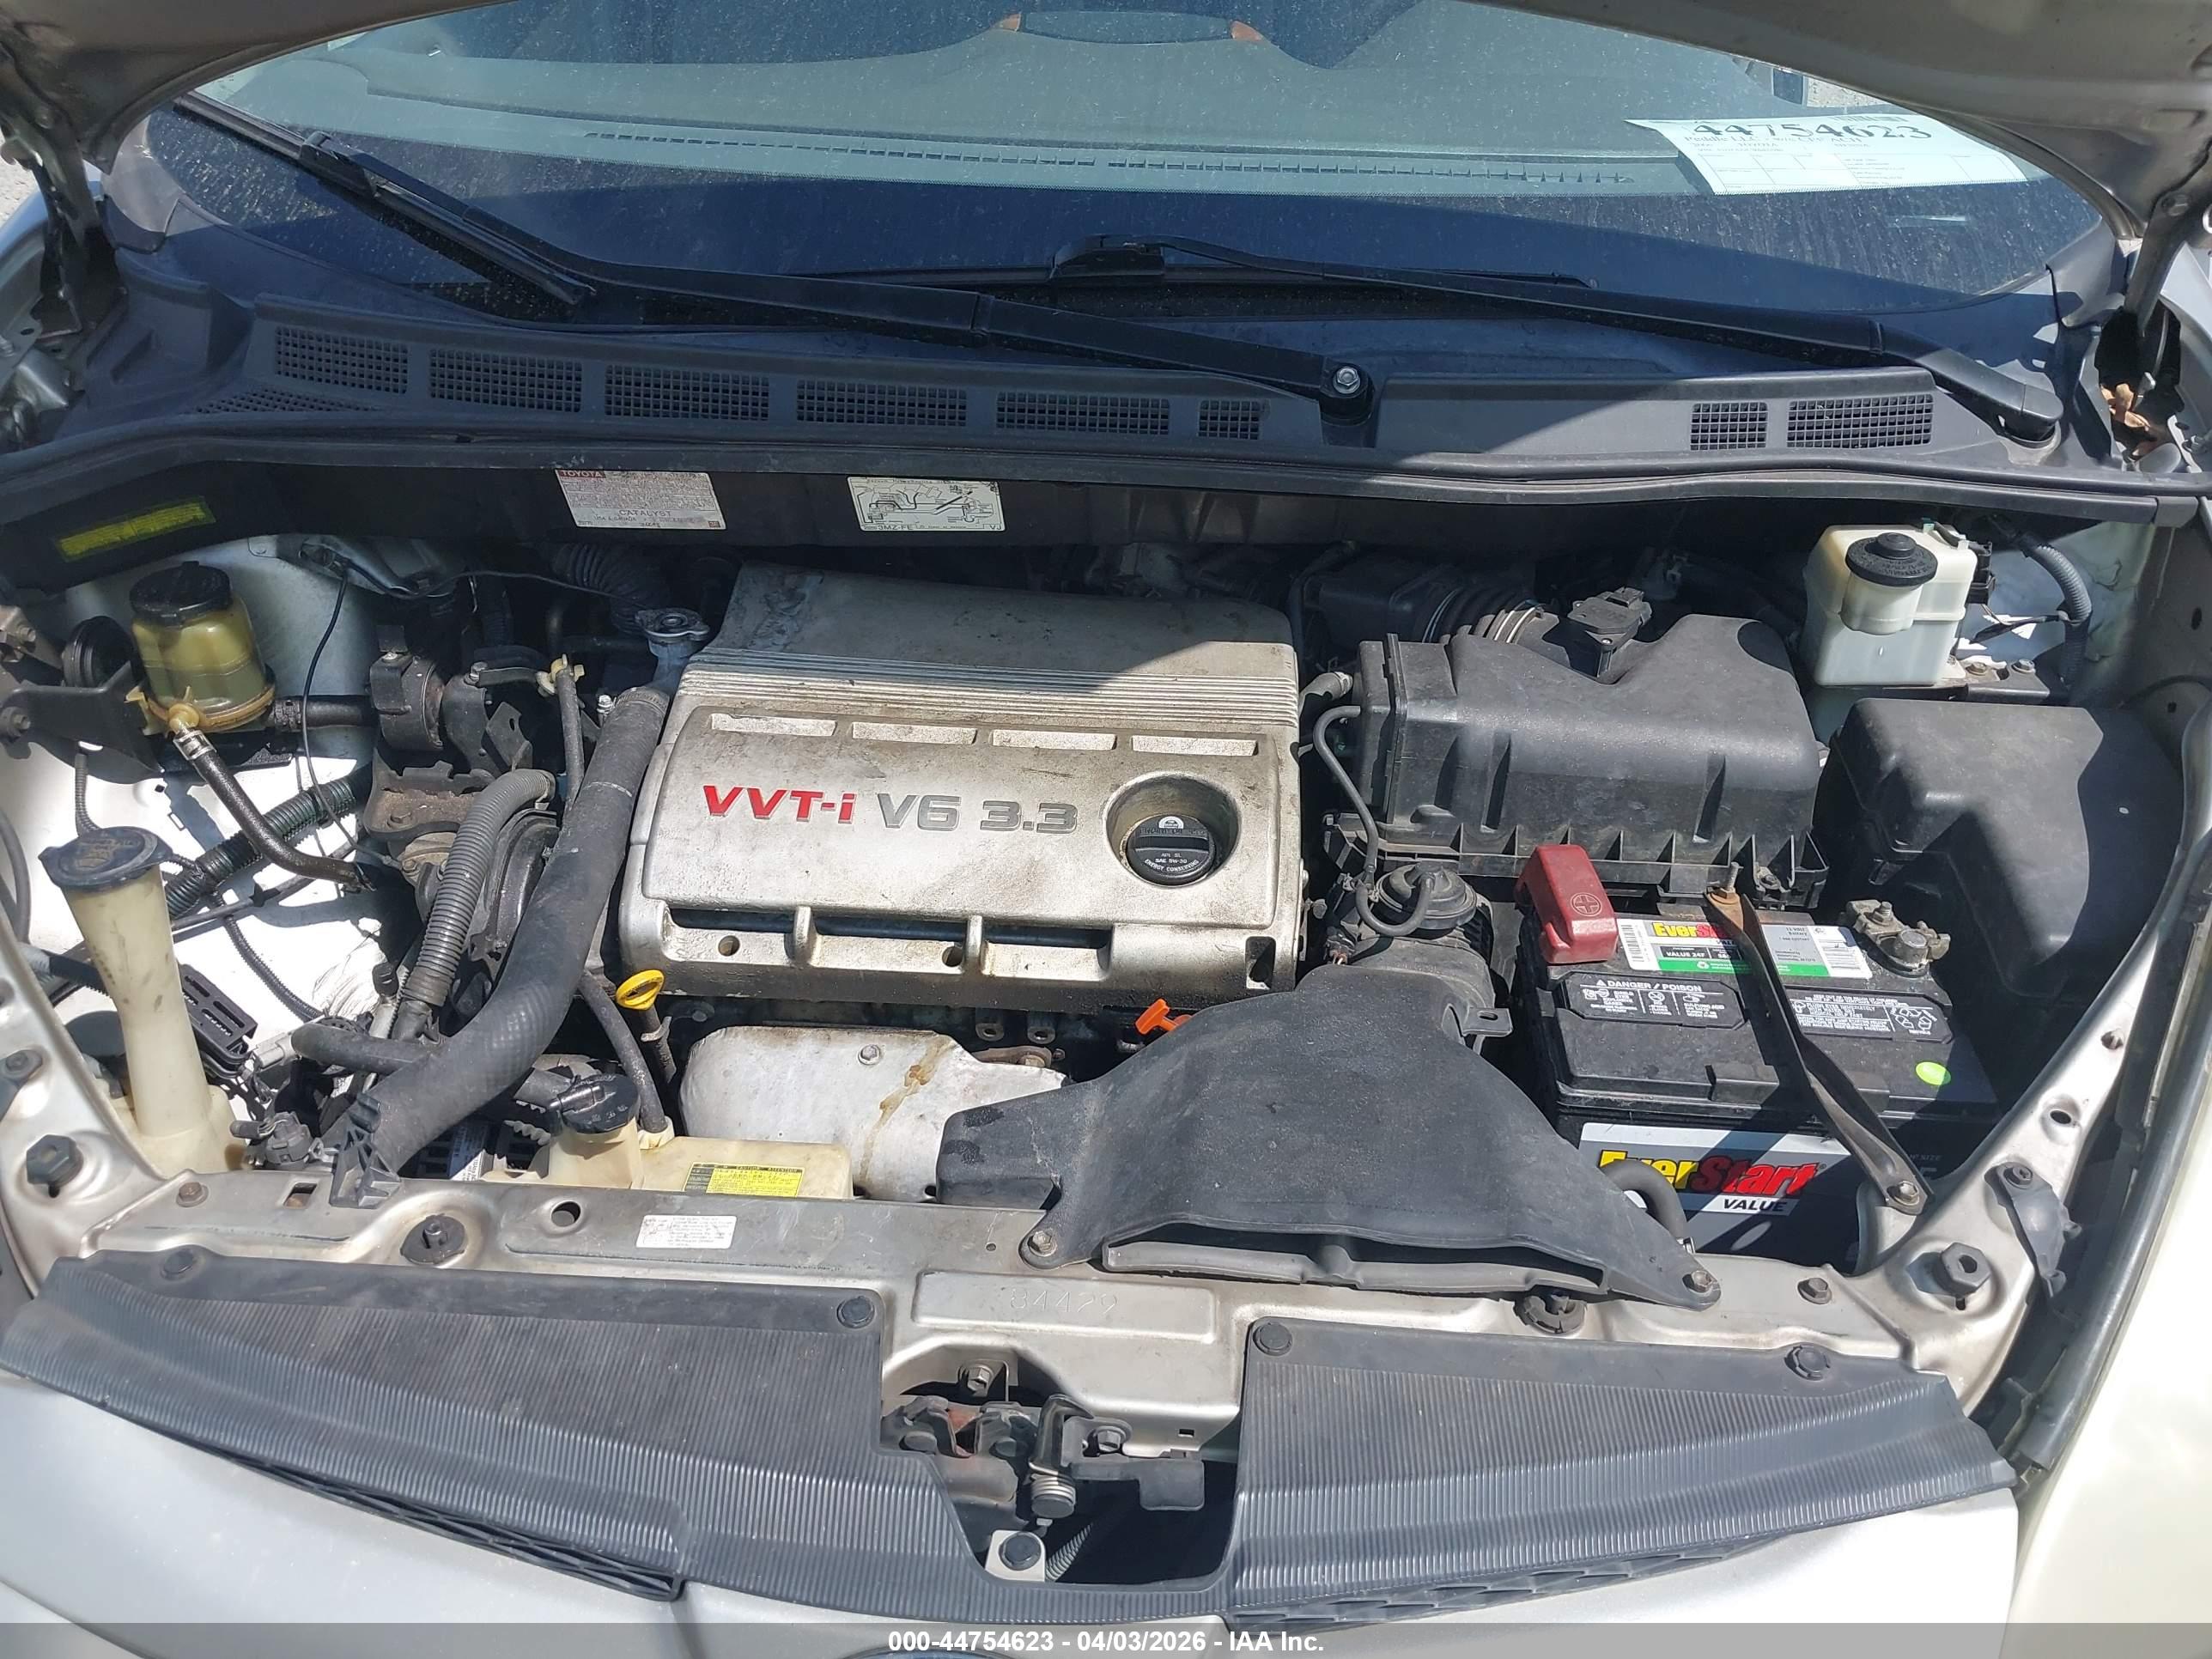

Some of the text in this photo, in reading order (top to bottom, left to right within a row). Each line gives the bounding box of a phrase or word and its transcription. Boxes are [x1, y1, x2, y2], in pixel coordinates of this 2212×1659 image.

[1693, 124, 1932, 138] 44754623
[562, 470, 604, 478] TOYOTA
[702, 784, 1079, 835] VVT-i V6 3.3
[1144, 859, 1200, 872] ENERGY CONSERVING
[1652, 921, 1735, 939] EverSt
[1607, 980, 1651, 989] DANGER
[1662, 983, 1703, 993] POISON
[1599, 1149, 1820, 1196] erStart
[1723, 1198, 1788, 1212] VALUE
